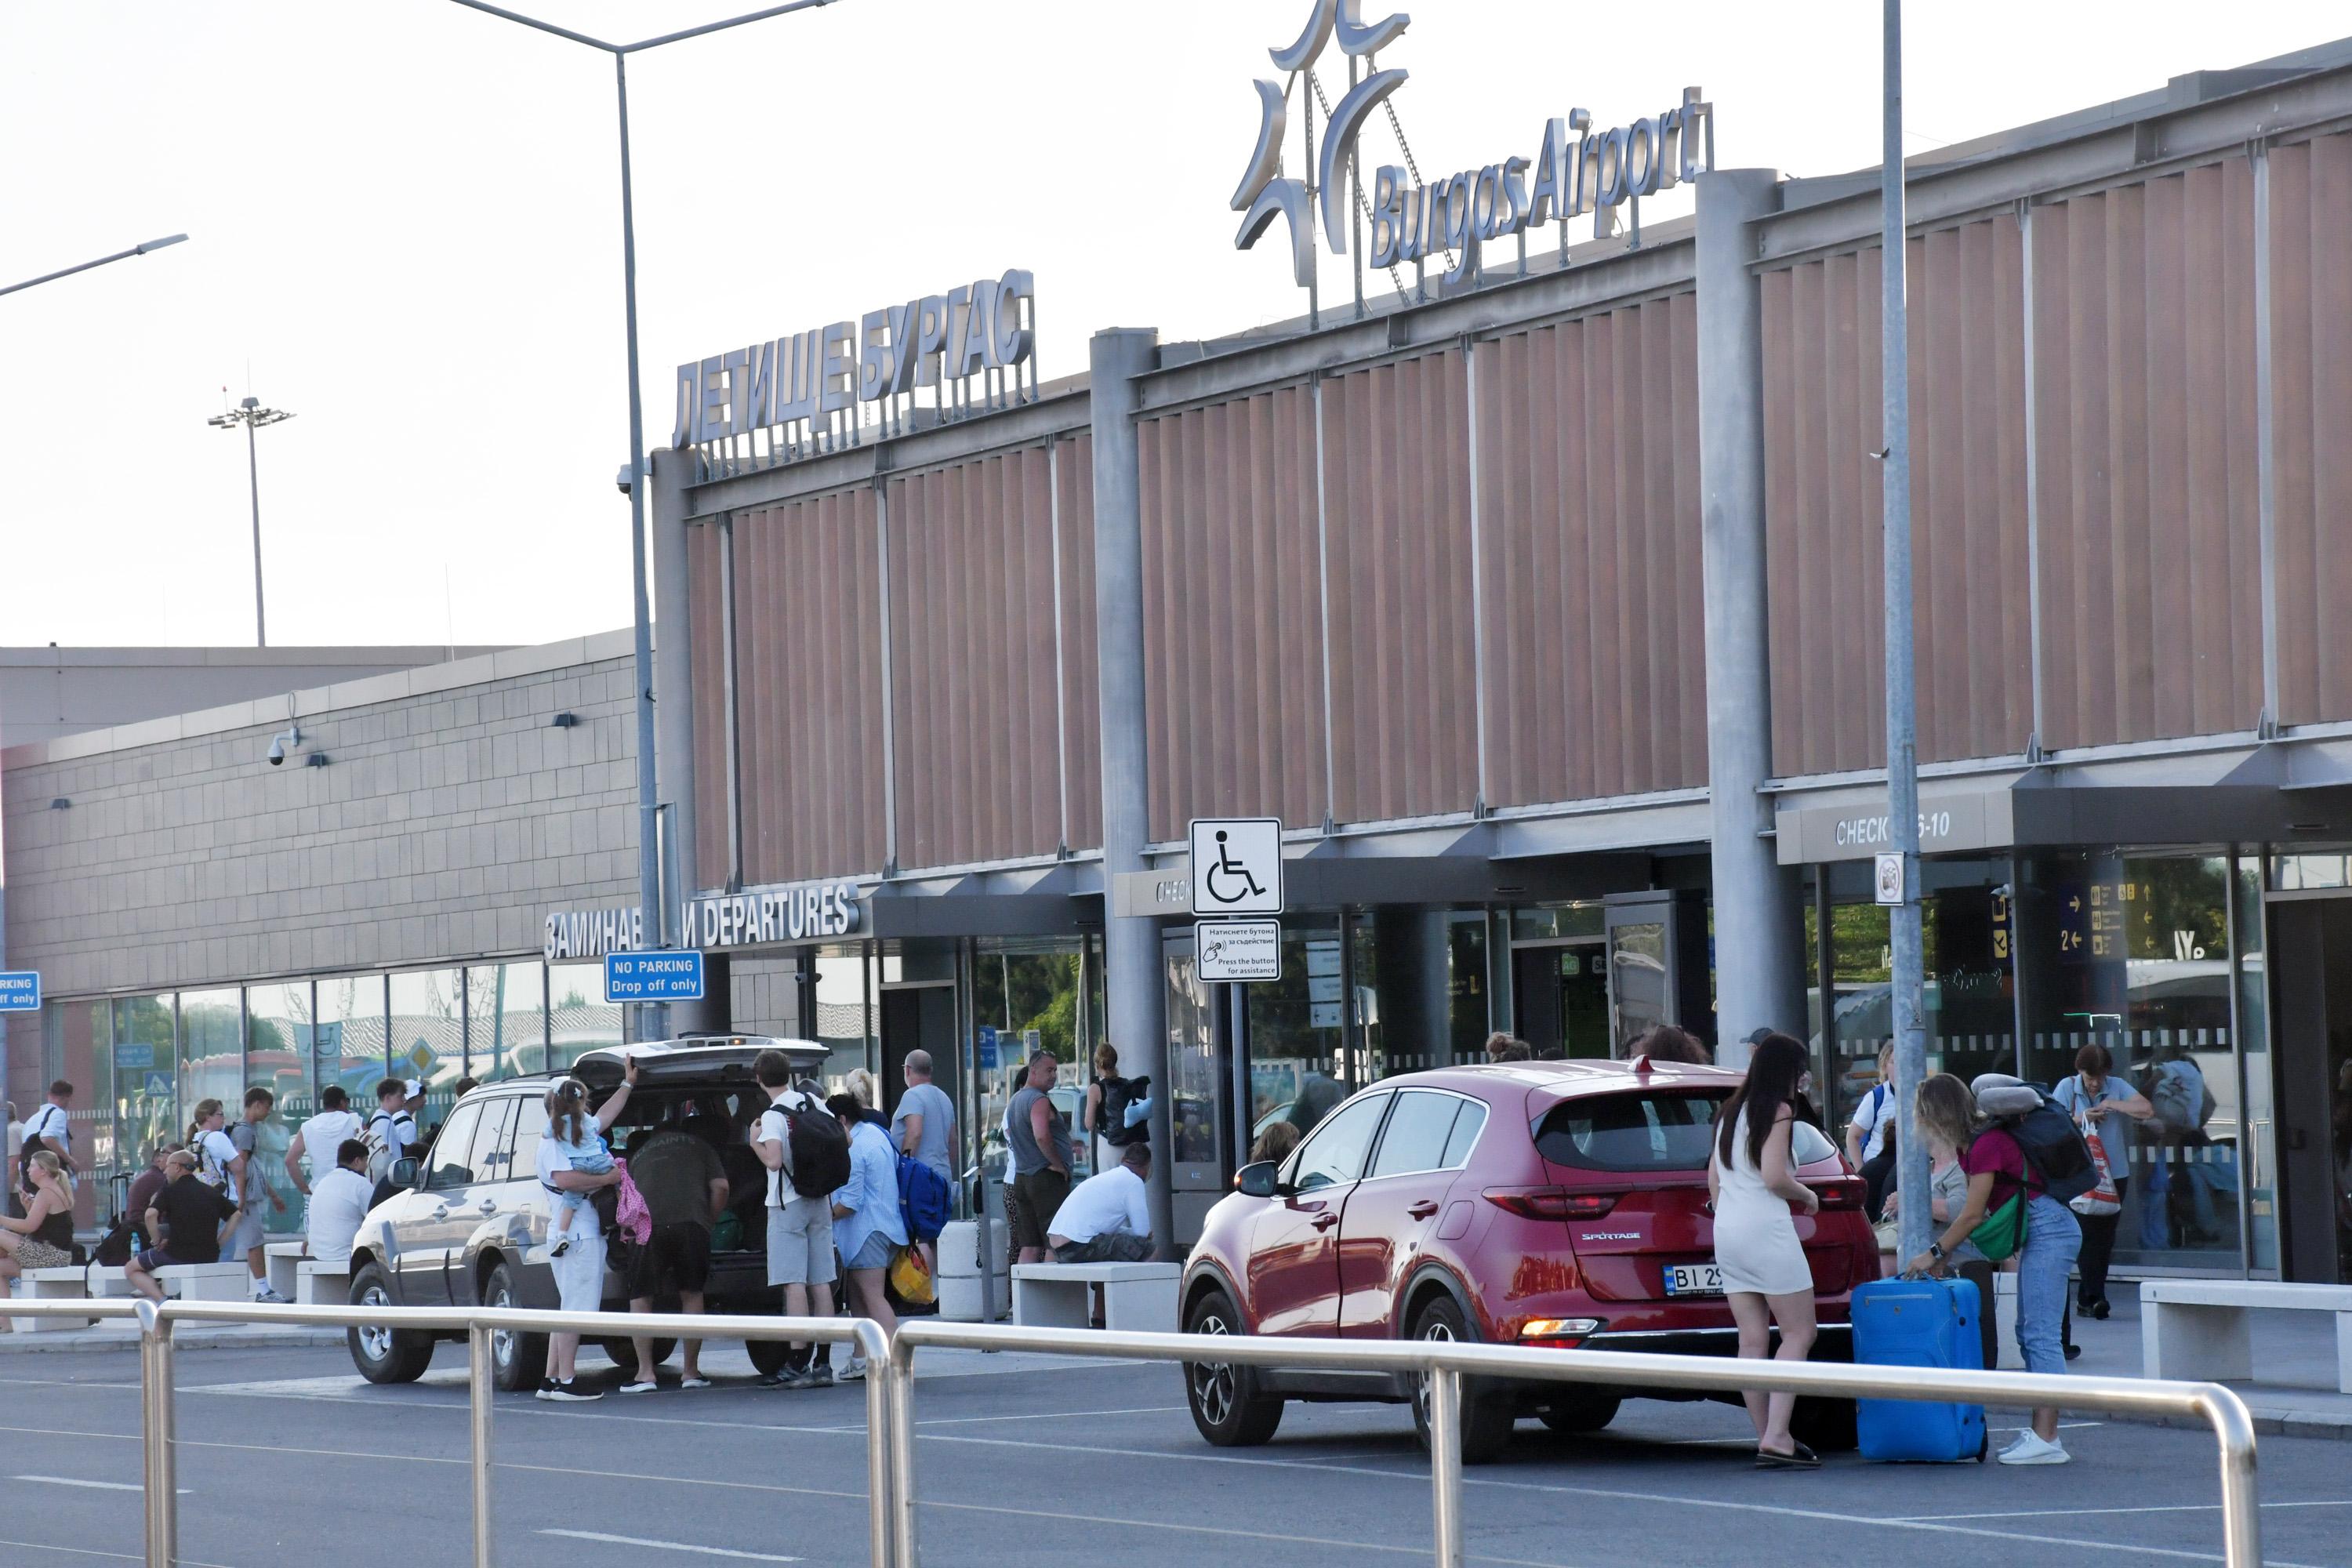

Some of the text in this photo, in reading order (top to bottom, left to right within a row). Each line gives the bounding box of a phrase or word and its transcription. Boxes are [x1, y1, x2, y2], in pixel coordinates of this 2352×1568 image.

[1370, 86, 1714, 285] Burgas Airport
[672, 268, 1033, 450] ЛЕТИЩЕ БУРГАС
[1836, 817, 1889, 846] CHECK
[704, 883, 851, 946] DEPARTURES
[544, 901, 696, 960] ЗАМИНАВИ
[1249, 927, 1274, 936] бутона
[615, 960, 693, 974] NO PARKING
[0, 978, 32, 989] RKING
[612, 978, 697, 995] Drop off only
[0, 993, 35, 1005] ff only
[1581, 1232, 1641, 1240] SPORTAGE
[1675, 1268, 1697, 1287] BI
